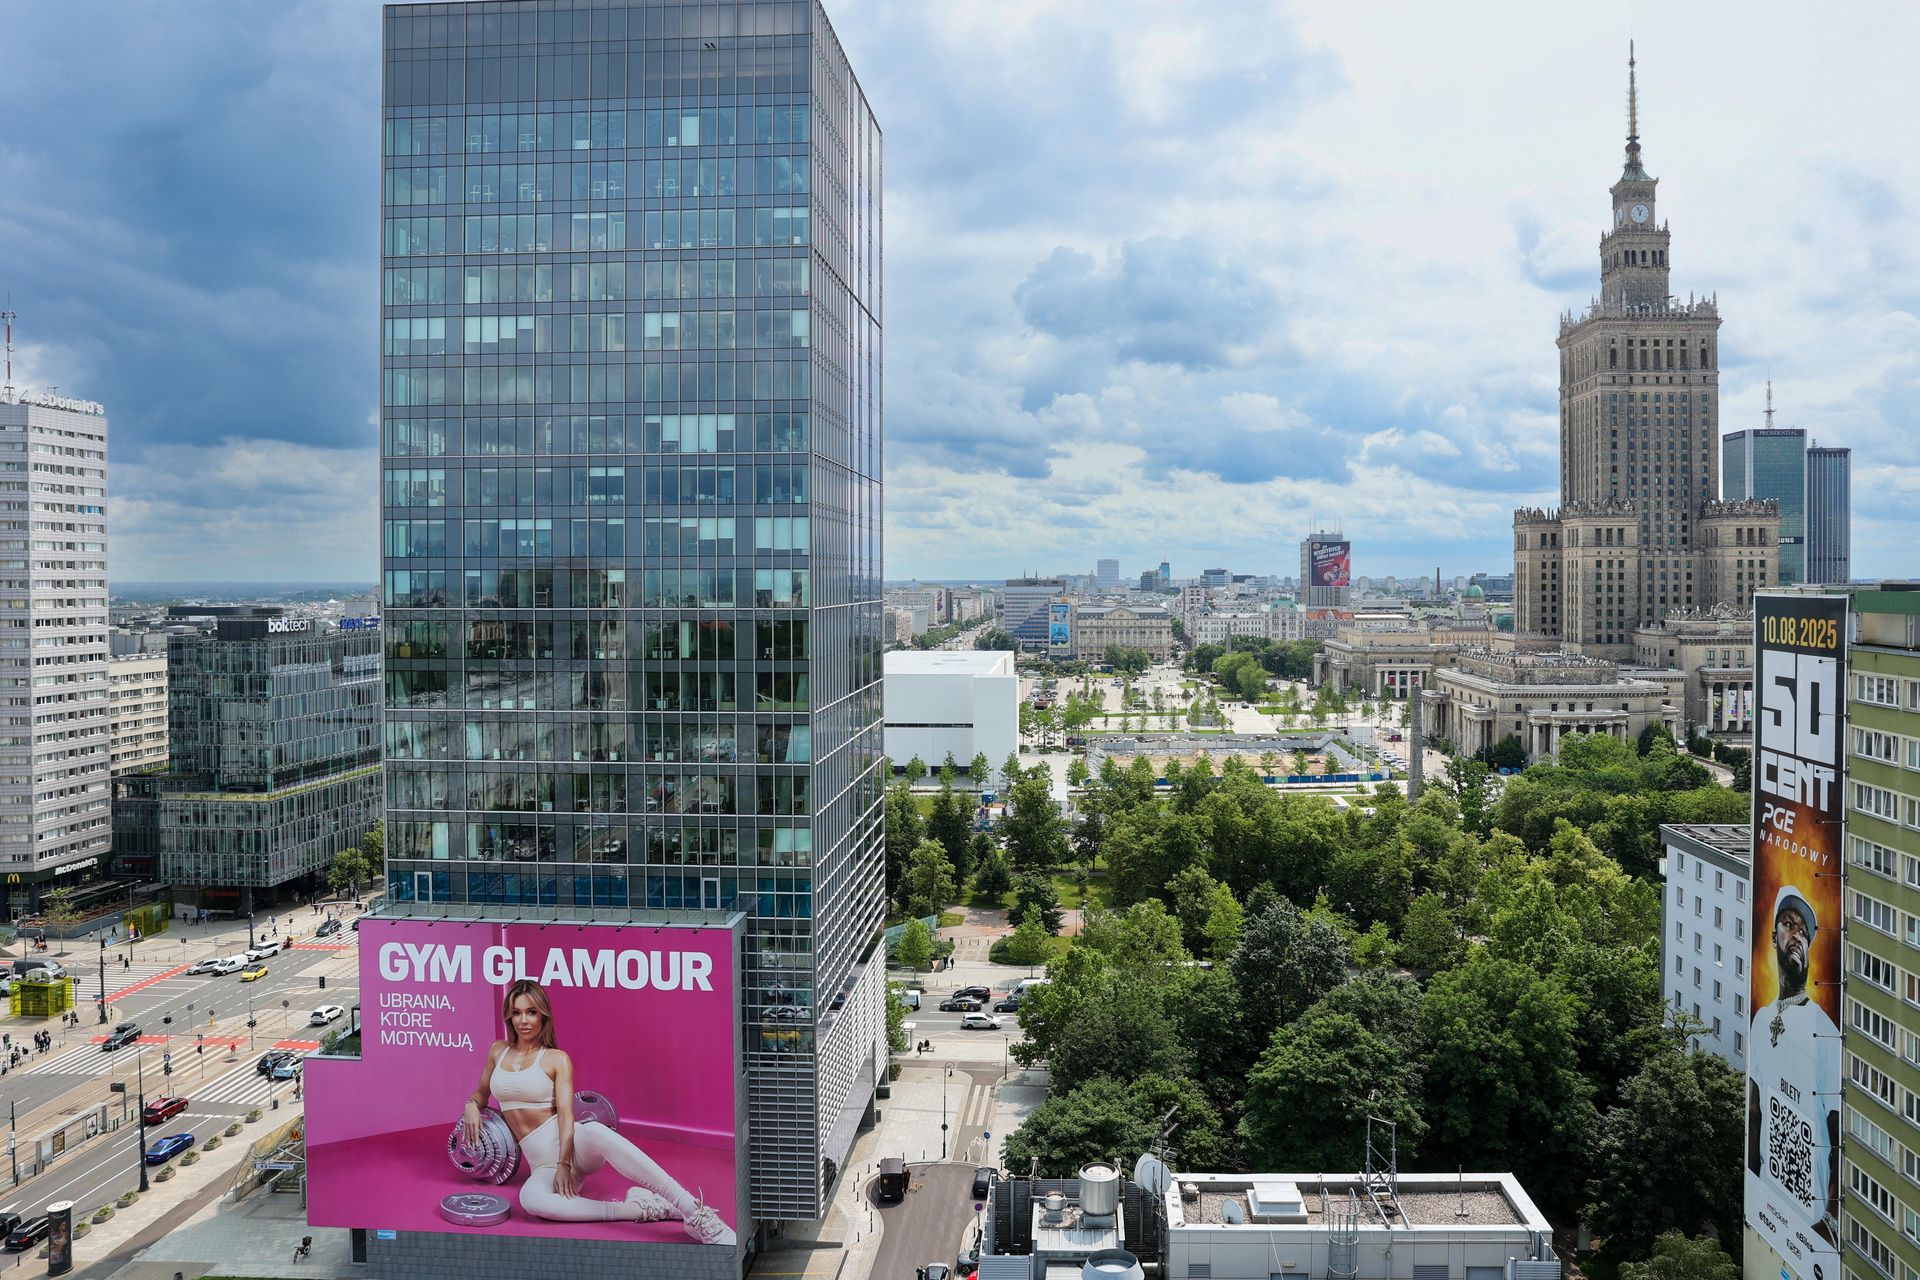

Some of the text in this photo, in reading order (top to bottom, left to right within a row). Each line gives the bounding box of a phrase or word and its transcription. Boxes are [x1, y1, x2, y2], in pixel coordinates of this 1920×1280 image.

[268, 617, 311, 632] bolttech
[1762, 615, 1837, 649] 10.08.2025
[1761, 649, 1837, 766] 50
[1760, 749, 1836, 813] CENT
[1762, 802, 1796, 834] PGE
[1759, 828, 1829, 867] NARODOWY
[54, 857, 99, 876] McDonald's
[379, 942, 714, 992] GYM GLAMOUR
[379, 993, 456, 1012] UBRANIA,
[380, 1009, 432, 1028] KTÓRE
[381, 1030, 473, 1052] MOTYWUJĄ
[1780, 1077, 1801, 1105] BILETY
